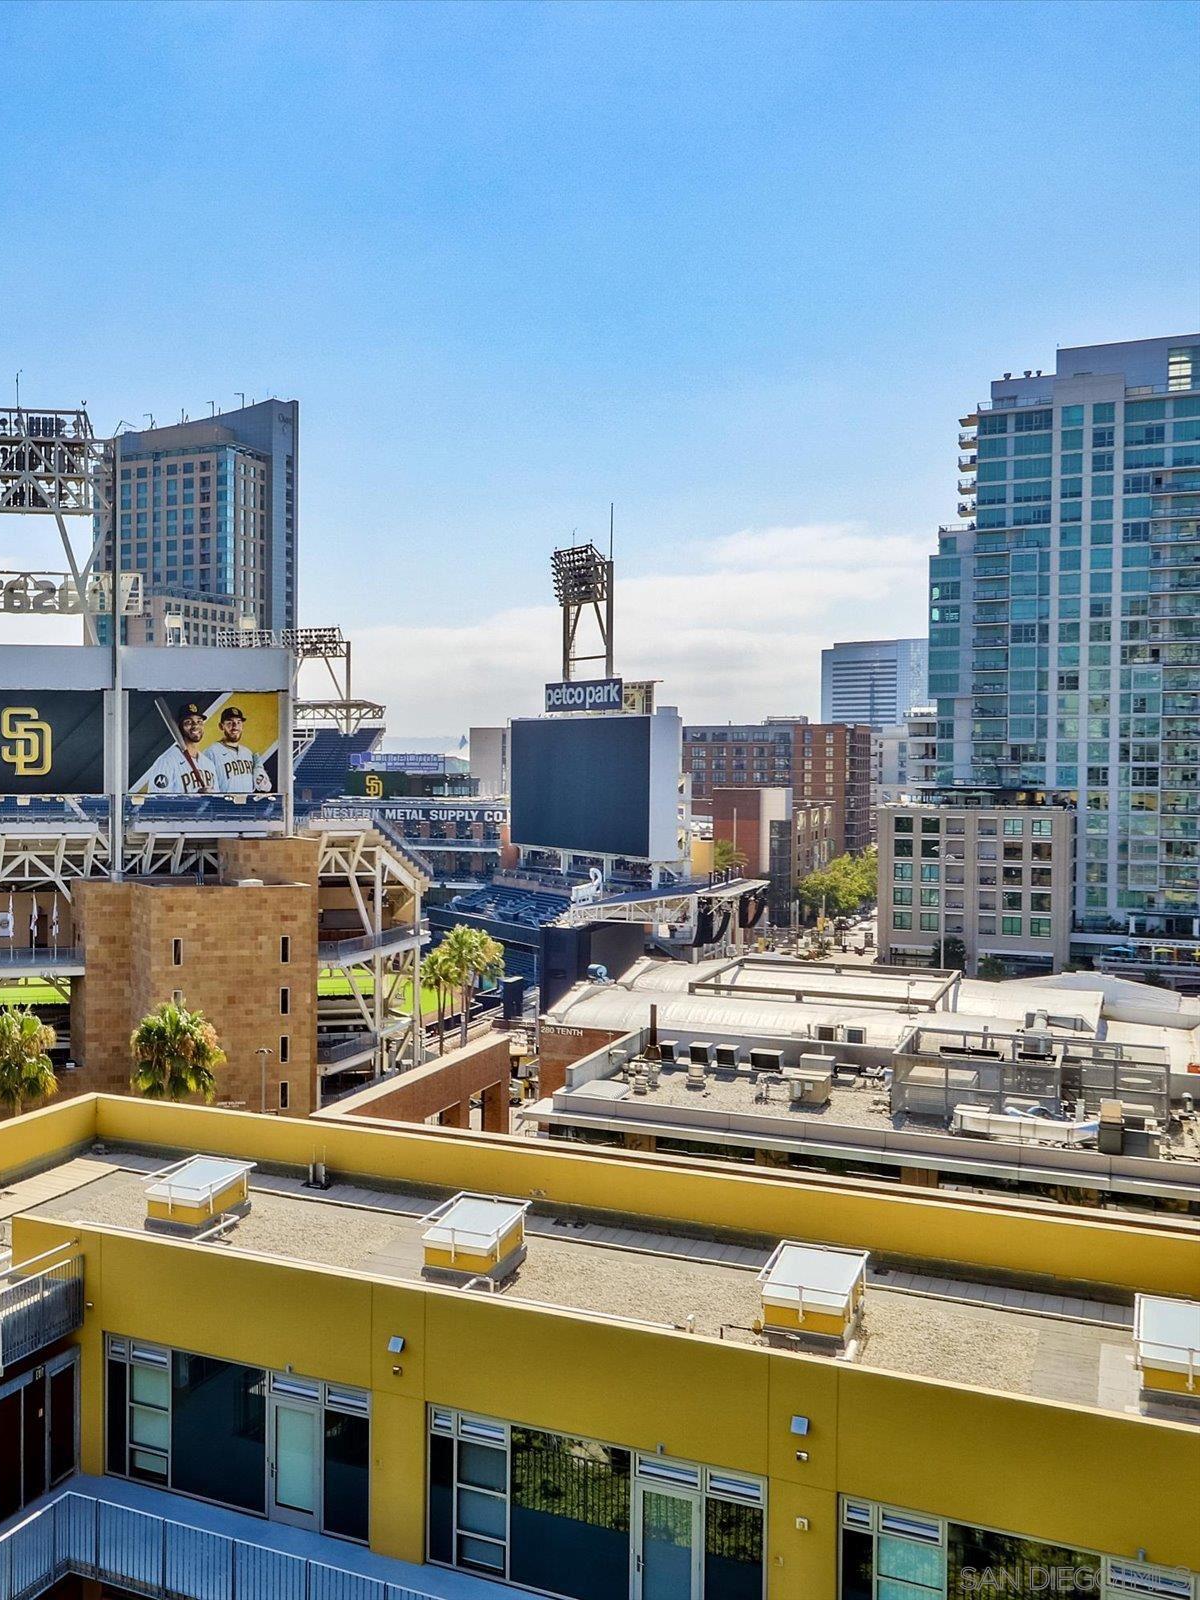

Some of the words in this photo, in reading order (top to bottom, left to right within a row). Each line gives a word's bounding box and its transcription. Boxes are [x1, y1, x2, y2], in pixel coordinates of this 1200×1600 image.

[546, 684, 584, 711] petco
[586, 682, 620, 709] park
[1, 706, 52, 776] SD
[365, 775, 383, 799] SD
[323, 807, 380, 820] WESTERN
[385, 809, 426, 821] METAL
[430, 810, 479, 822] SUPPLY
[484, 811, 506, 823] CO.
[540, 1026, 555, 1034] 280
[556, 1027, 583, 1037] TENTH
